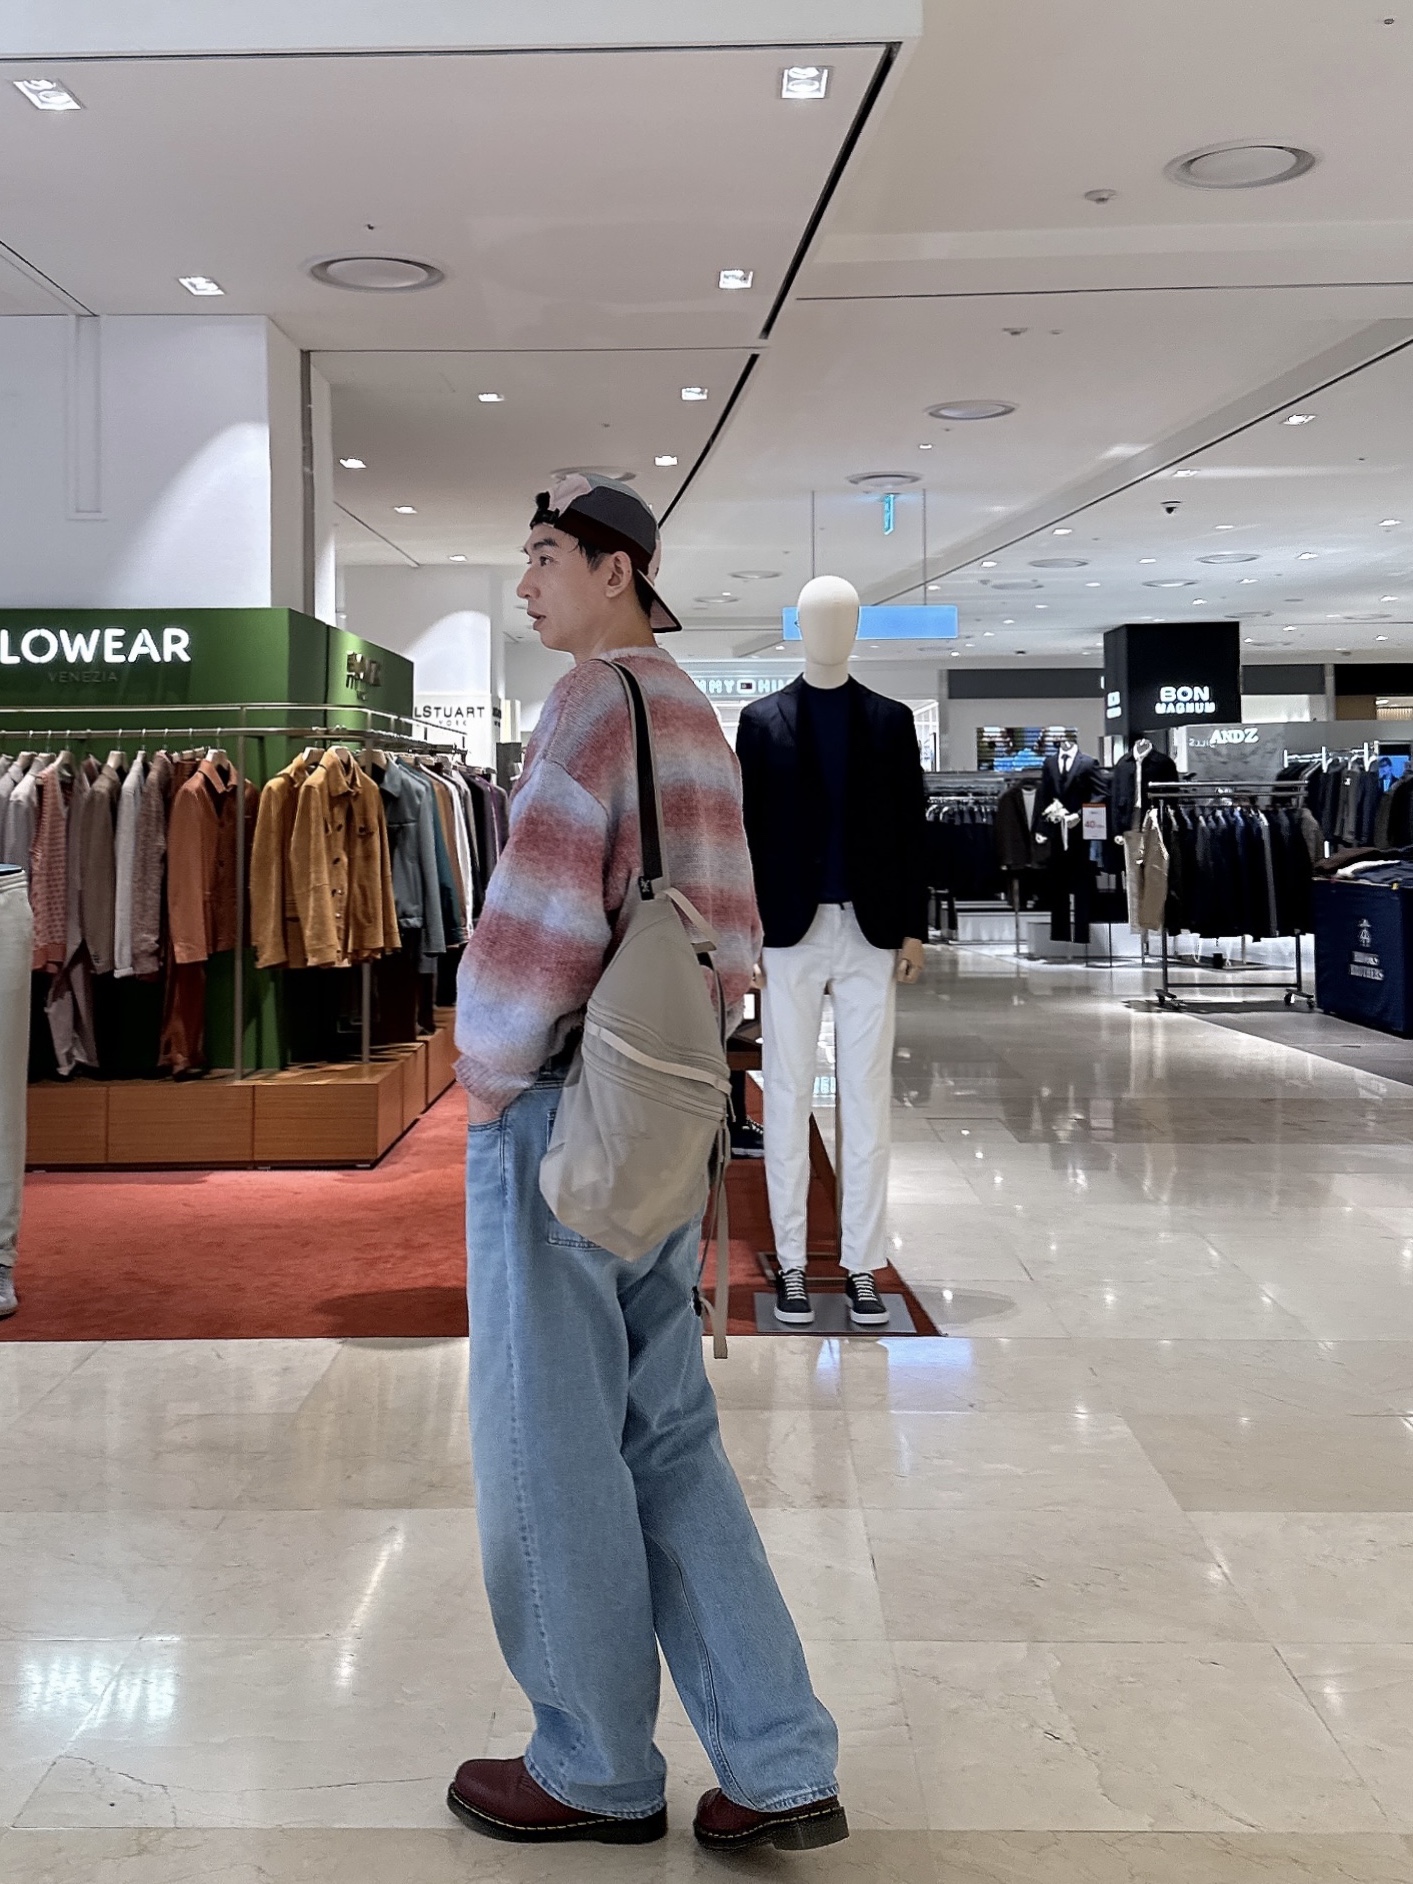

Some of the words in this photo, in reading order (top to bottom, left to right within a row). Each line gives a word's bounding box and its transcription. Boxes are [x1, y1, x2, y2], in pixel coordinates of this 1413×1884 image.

[0, 627, 192, 665] LOWEAR
[50, 671, 119, 683] VENEZIA
[1160, 685, 1210, 702] BON
[414, 705, 485, 719] LSTUART
[1155, 702, 1216, 715] MAGNUM
[1209, 727, 1259, 744] ANDZ
